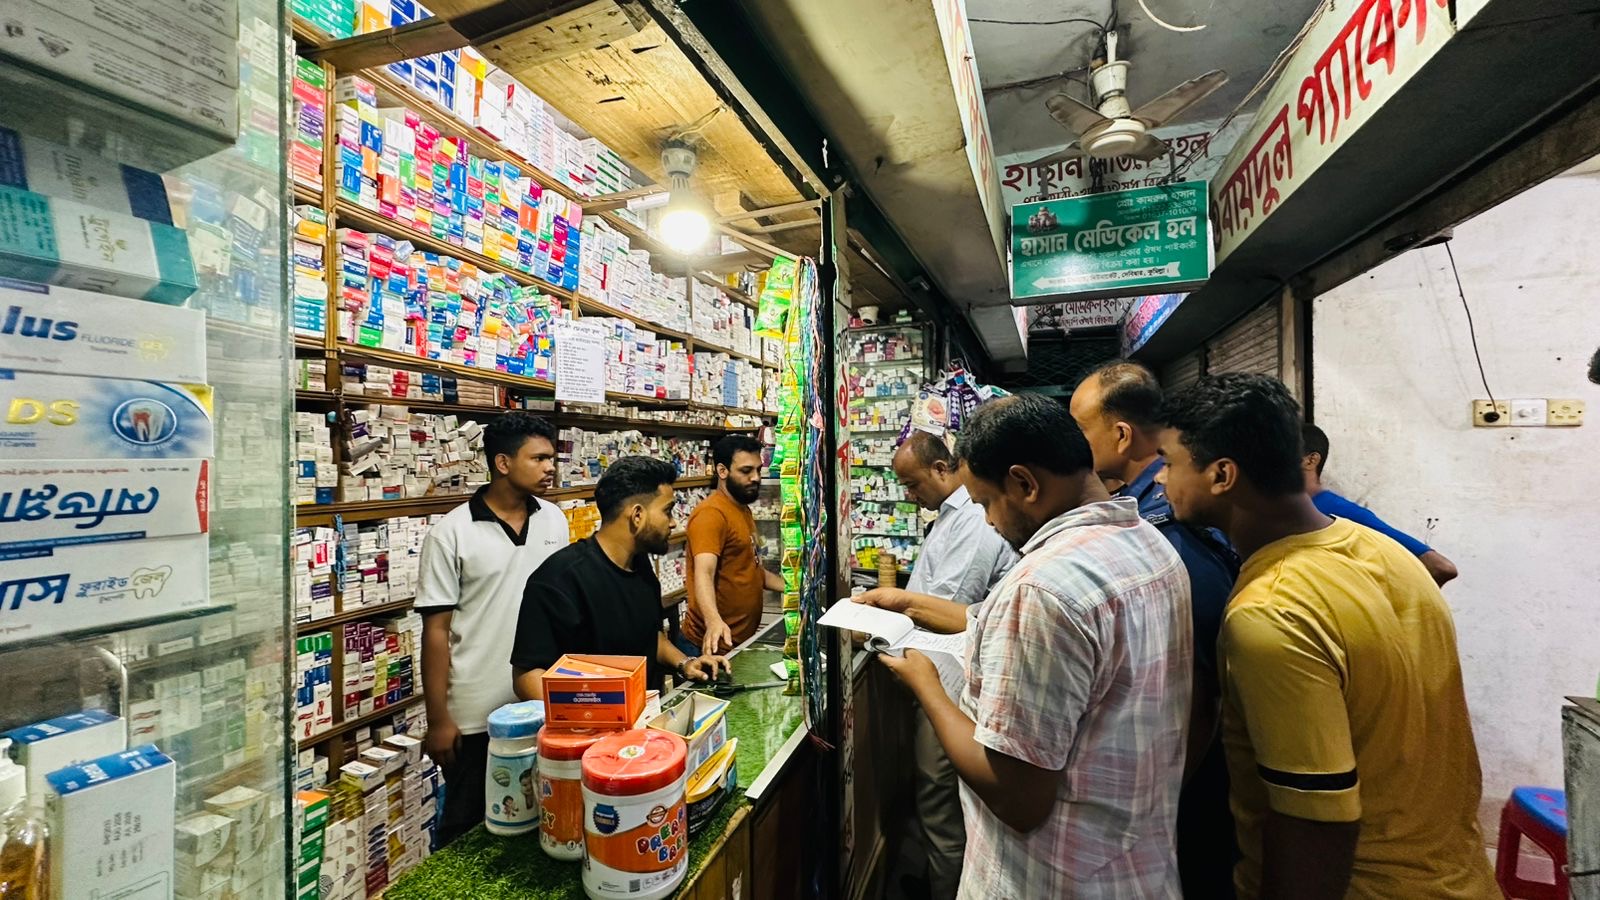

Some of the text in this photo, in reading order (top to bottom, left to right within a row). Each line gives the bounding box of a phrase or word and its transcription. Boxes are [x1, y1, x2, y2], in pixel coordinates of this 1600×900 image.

[1020, 216, 1198, 257] হাসান মেডিকেল হল
[81, 333, 136, 348] FLUORIDE
[6, 396, 80, 426] DS
